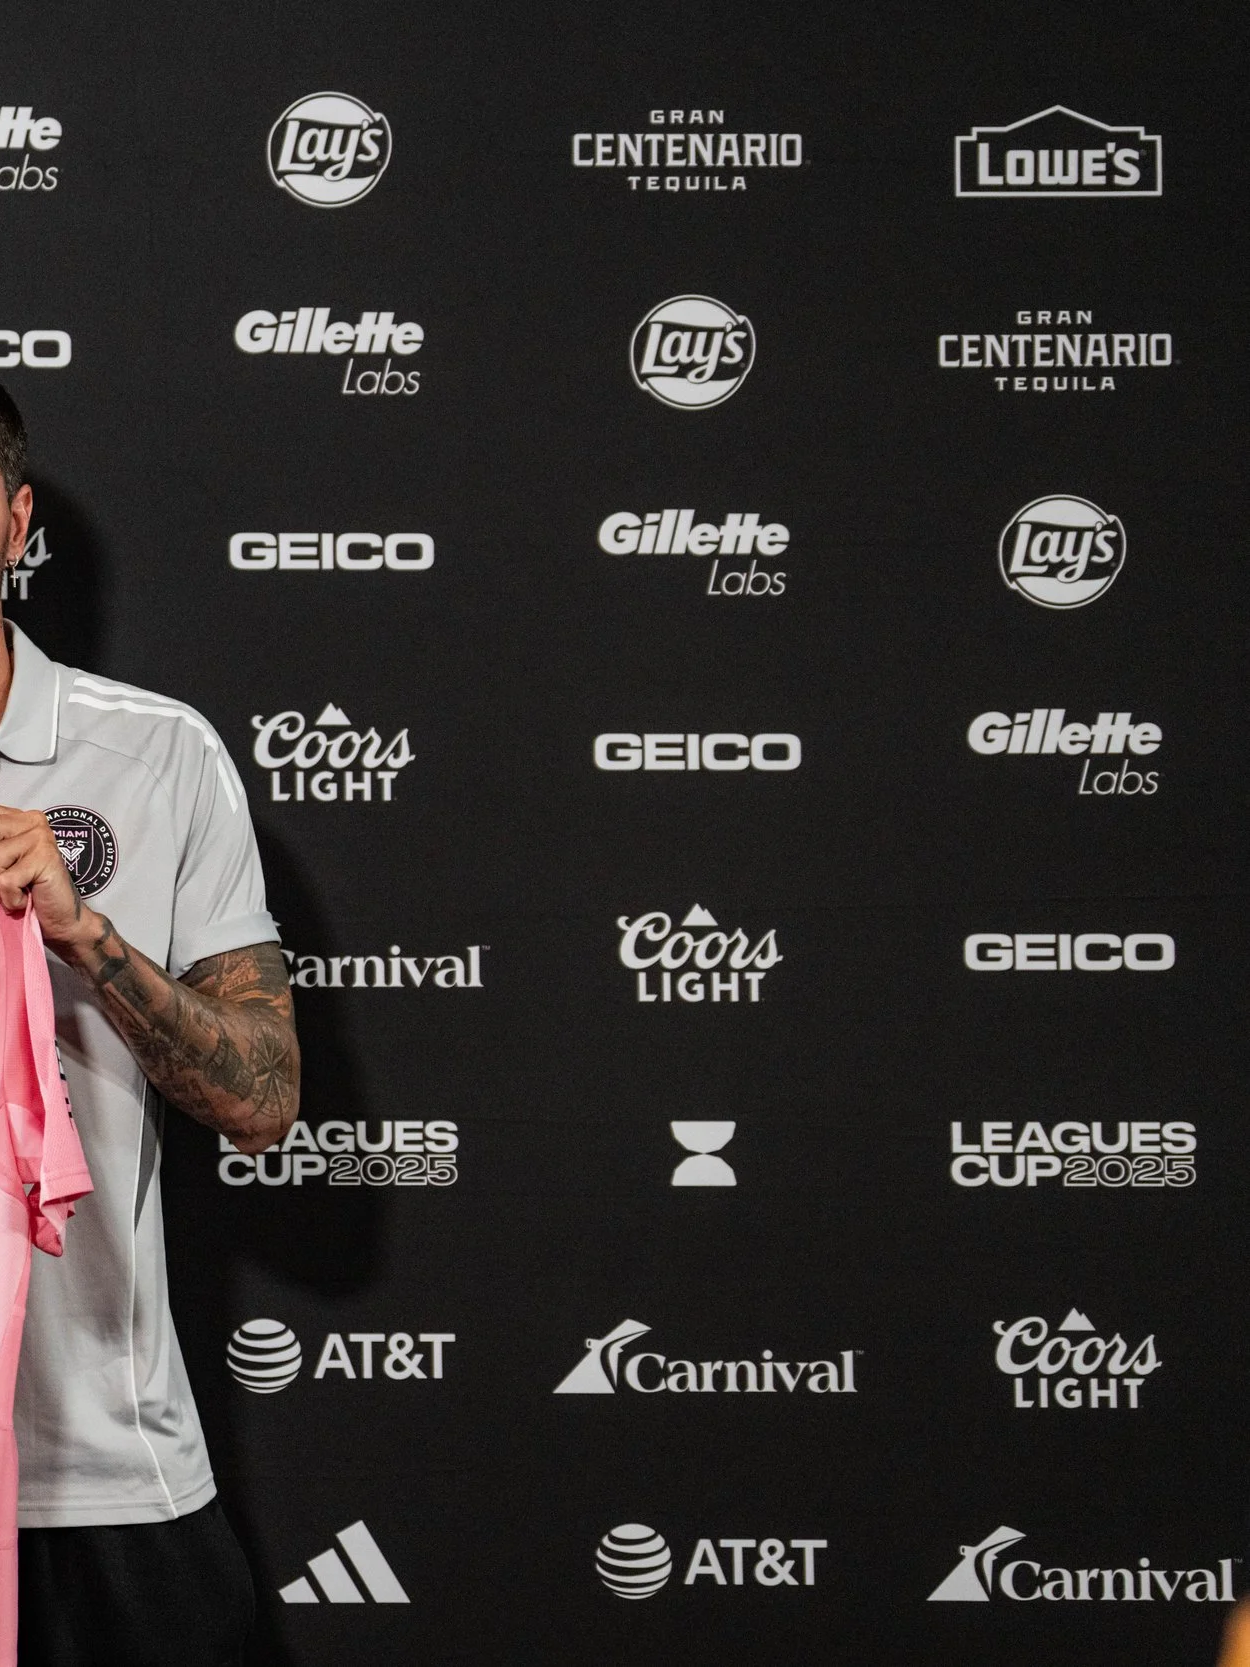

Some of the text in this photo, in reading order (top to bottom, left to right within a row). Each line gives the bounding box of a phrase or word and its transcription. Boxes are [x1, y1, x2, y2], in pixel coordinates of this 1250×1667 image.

[651, 111, 724, 125] GRAN
[277, 120, 384, 181] Lay's
[574, 135, 803, 167] CENTENARIO
[978, 142, 1141, 186] LOWE'S
[629, 177, 747, 192] TEQUILA
[235, 308, 425, 356] Gillette
[1018, 312, 1092, 325] GRAN
[640, 323, 747, 385] Lay's
[940, 335, 1172, 368] CENTENARIO
[343, 359, 421, 396] Labs
[996, 378, 1116, 393] TEQUILA
[599, 510, 790, 557] Gillette
[230, 534, 435, 571] GEICO
[1008, 522, 1116, 583] Lay's
[709, 561, 787, 596] Labs
[252, 712, 416, 769] Coors
[969, 710, 1163, 756] Gillette
[595, 734, 802, 771] GEICO
[273, 772, 399, 802] LIGHT
[1080, 760, 1159, 796] Labs
[53, 830, 88, 838] MIAMI
[99, 826, 110, 839] DE
[617, 913, 784, 970] Coors
[965, 935, 1176, 972] GEICO
[639, 973, 766, 1003] LIGHT
[219, 1121, 459, 1153] AGUES
[951, 1121, 1197, 1154] LEAGUES
[219, 1154, 458, 1186] CUP 2025
[951, 1154, 1197, 1187] CUP 2025
[315, 1334, 456, 1381] AT&T
[993, 1317, 1162, 1376] Coors
[624, 1348, 858, 1395] Carnival
[1016, 1379, 1145, 1409] LIGHT
[686, 1540, 828, 1587] AT&T
[1000, 1559, 1236, 1602] Carnival
